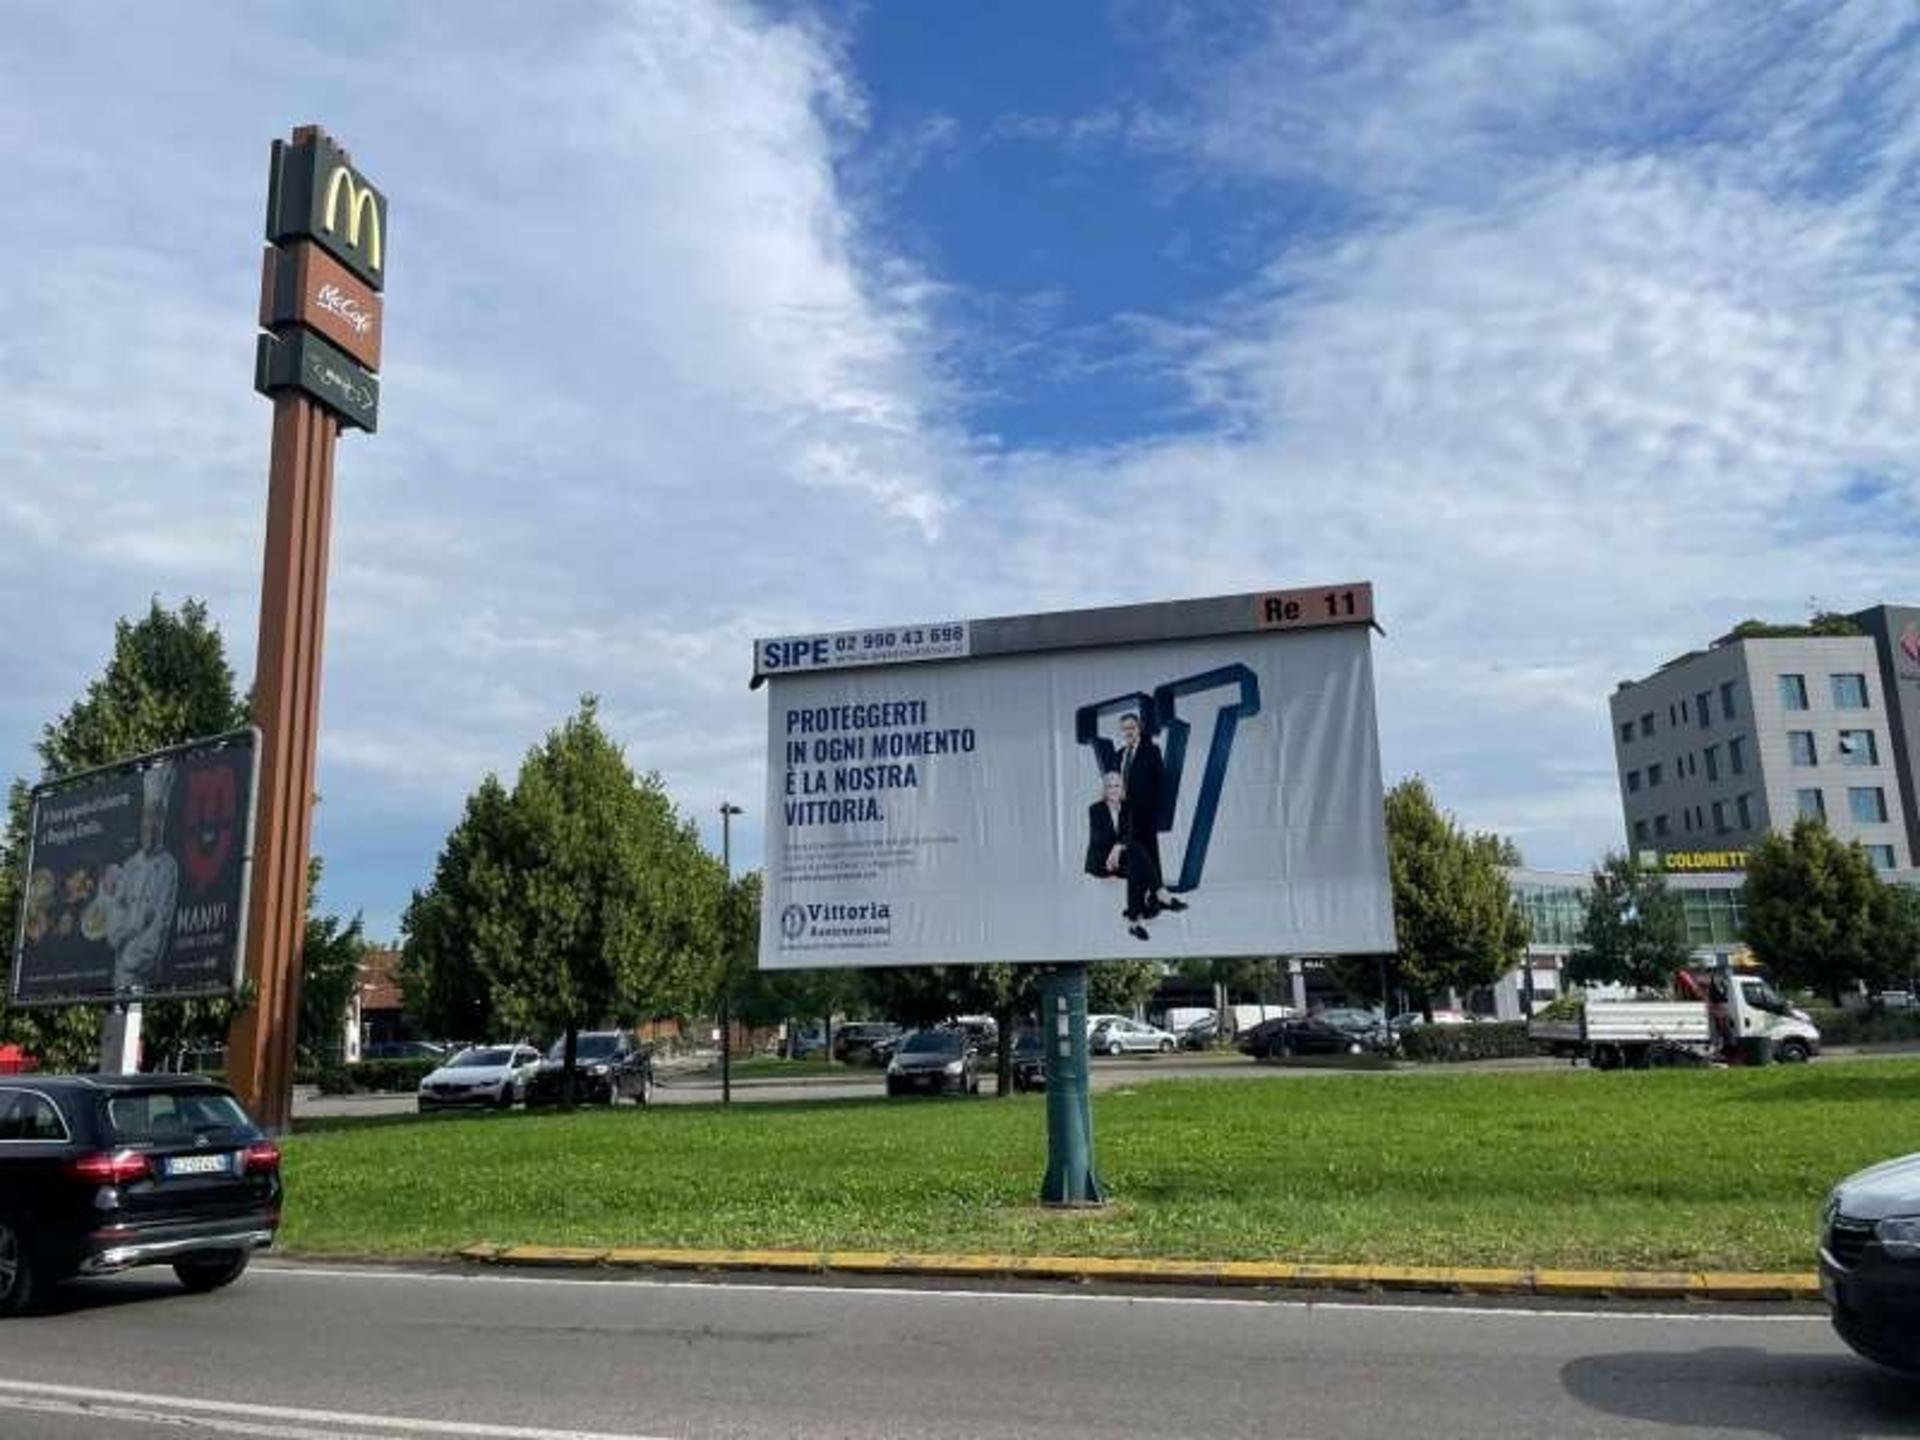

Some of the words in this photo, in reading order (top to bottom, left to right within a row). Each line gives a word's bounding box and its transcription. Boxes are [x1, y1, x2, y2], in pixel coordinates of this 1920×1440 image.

[325, 166, 380, 271] M
[1265, 597, 1299, 622] Re
[1324, 591, 1355, 617] 11
[764, 640, 828, 668] SIPE
[835, 636, 857, 651] 02
[902, 630, 923, 645] 43
[930, 626, 963, 643] 698
[787, 701, 926, 734] PROTEGGERTI
[787, 741, 807, 764] IN
[814, 736, 864, 764] OGNI
[873, 729, 975, 758] MOMENTO
[803, 770, 827, 794] LA
[835, 764, 917, 792] NOSTRA
[785, 798, 884, 826] VITTORIA.
[1665, 851, 1748, 868] COLDIRETT
[807, 902, 890, 921] Vittoria
